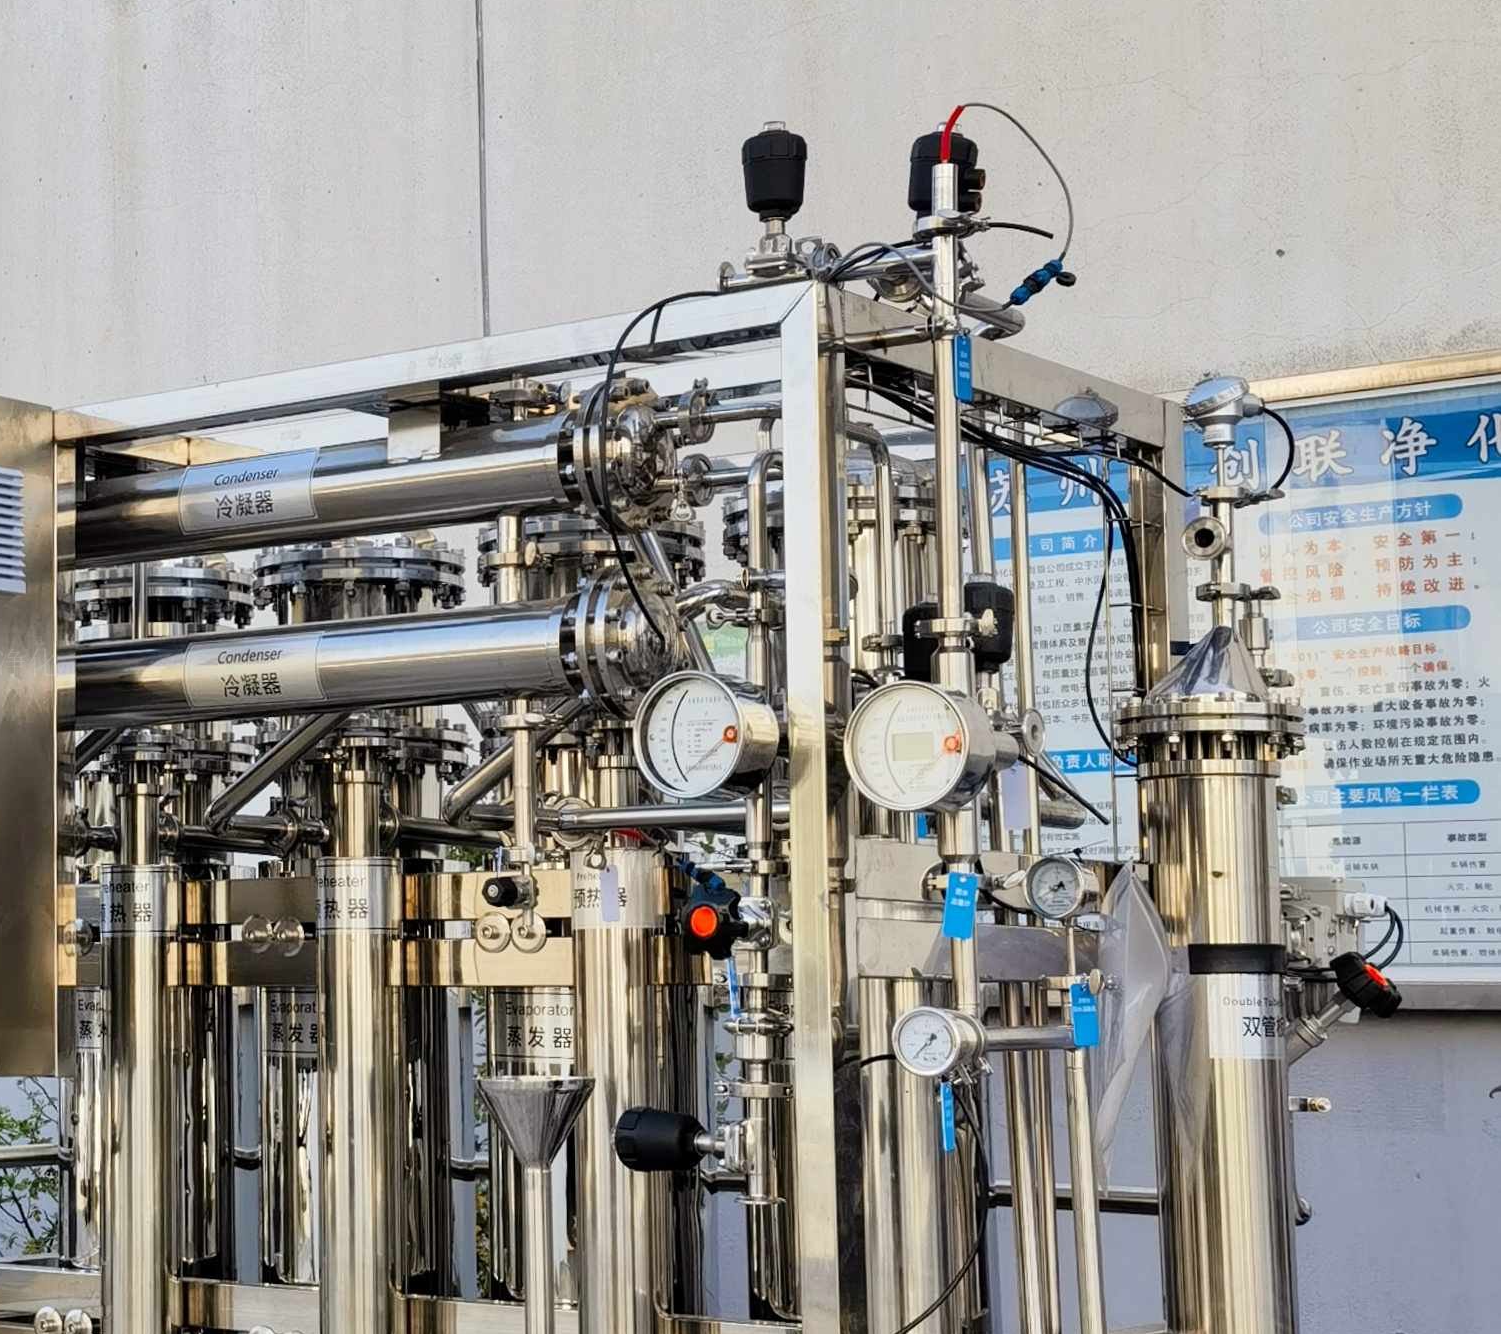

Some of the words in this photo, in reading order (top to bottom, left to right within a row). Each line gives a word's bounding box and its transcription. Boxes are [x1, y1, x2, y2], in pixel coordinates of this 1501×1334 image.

[214, 468, 278, 486] Condenser
[216, 490, 274, 519] 冷凝器
[1289, 503, 1432, 528] 公司安全生产方针
[1028, 534, 1098, 553] 司简介
[1314, 613, 1421, 634] 公司安全目标
[218, 648, 282, 664] Condenser
[221, 672, 282, 697] 冷凝器
[505, 1002, 574, 1018] Evaporator
[507, 1026, 573, 1050] 蒸发器
